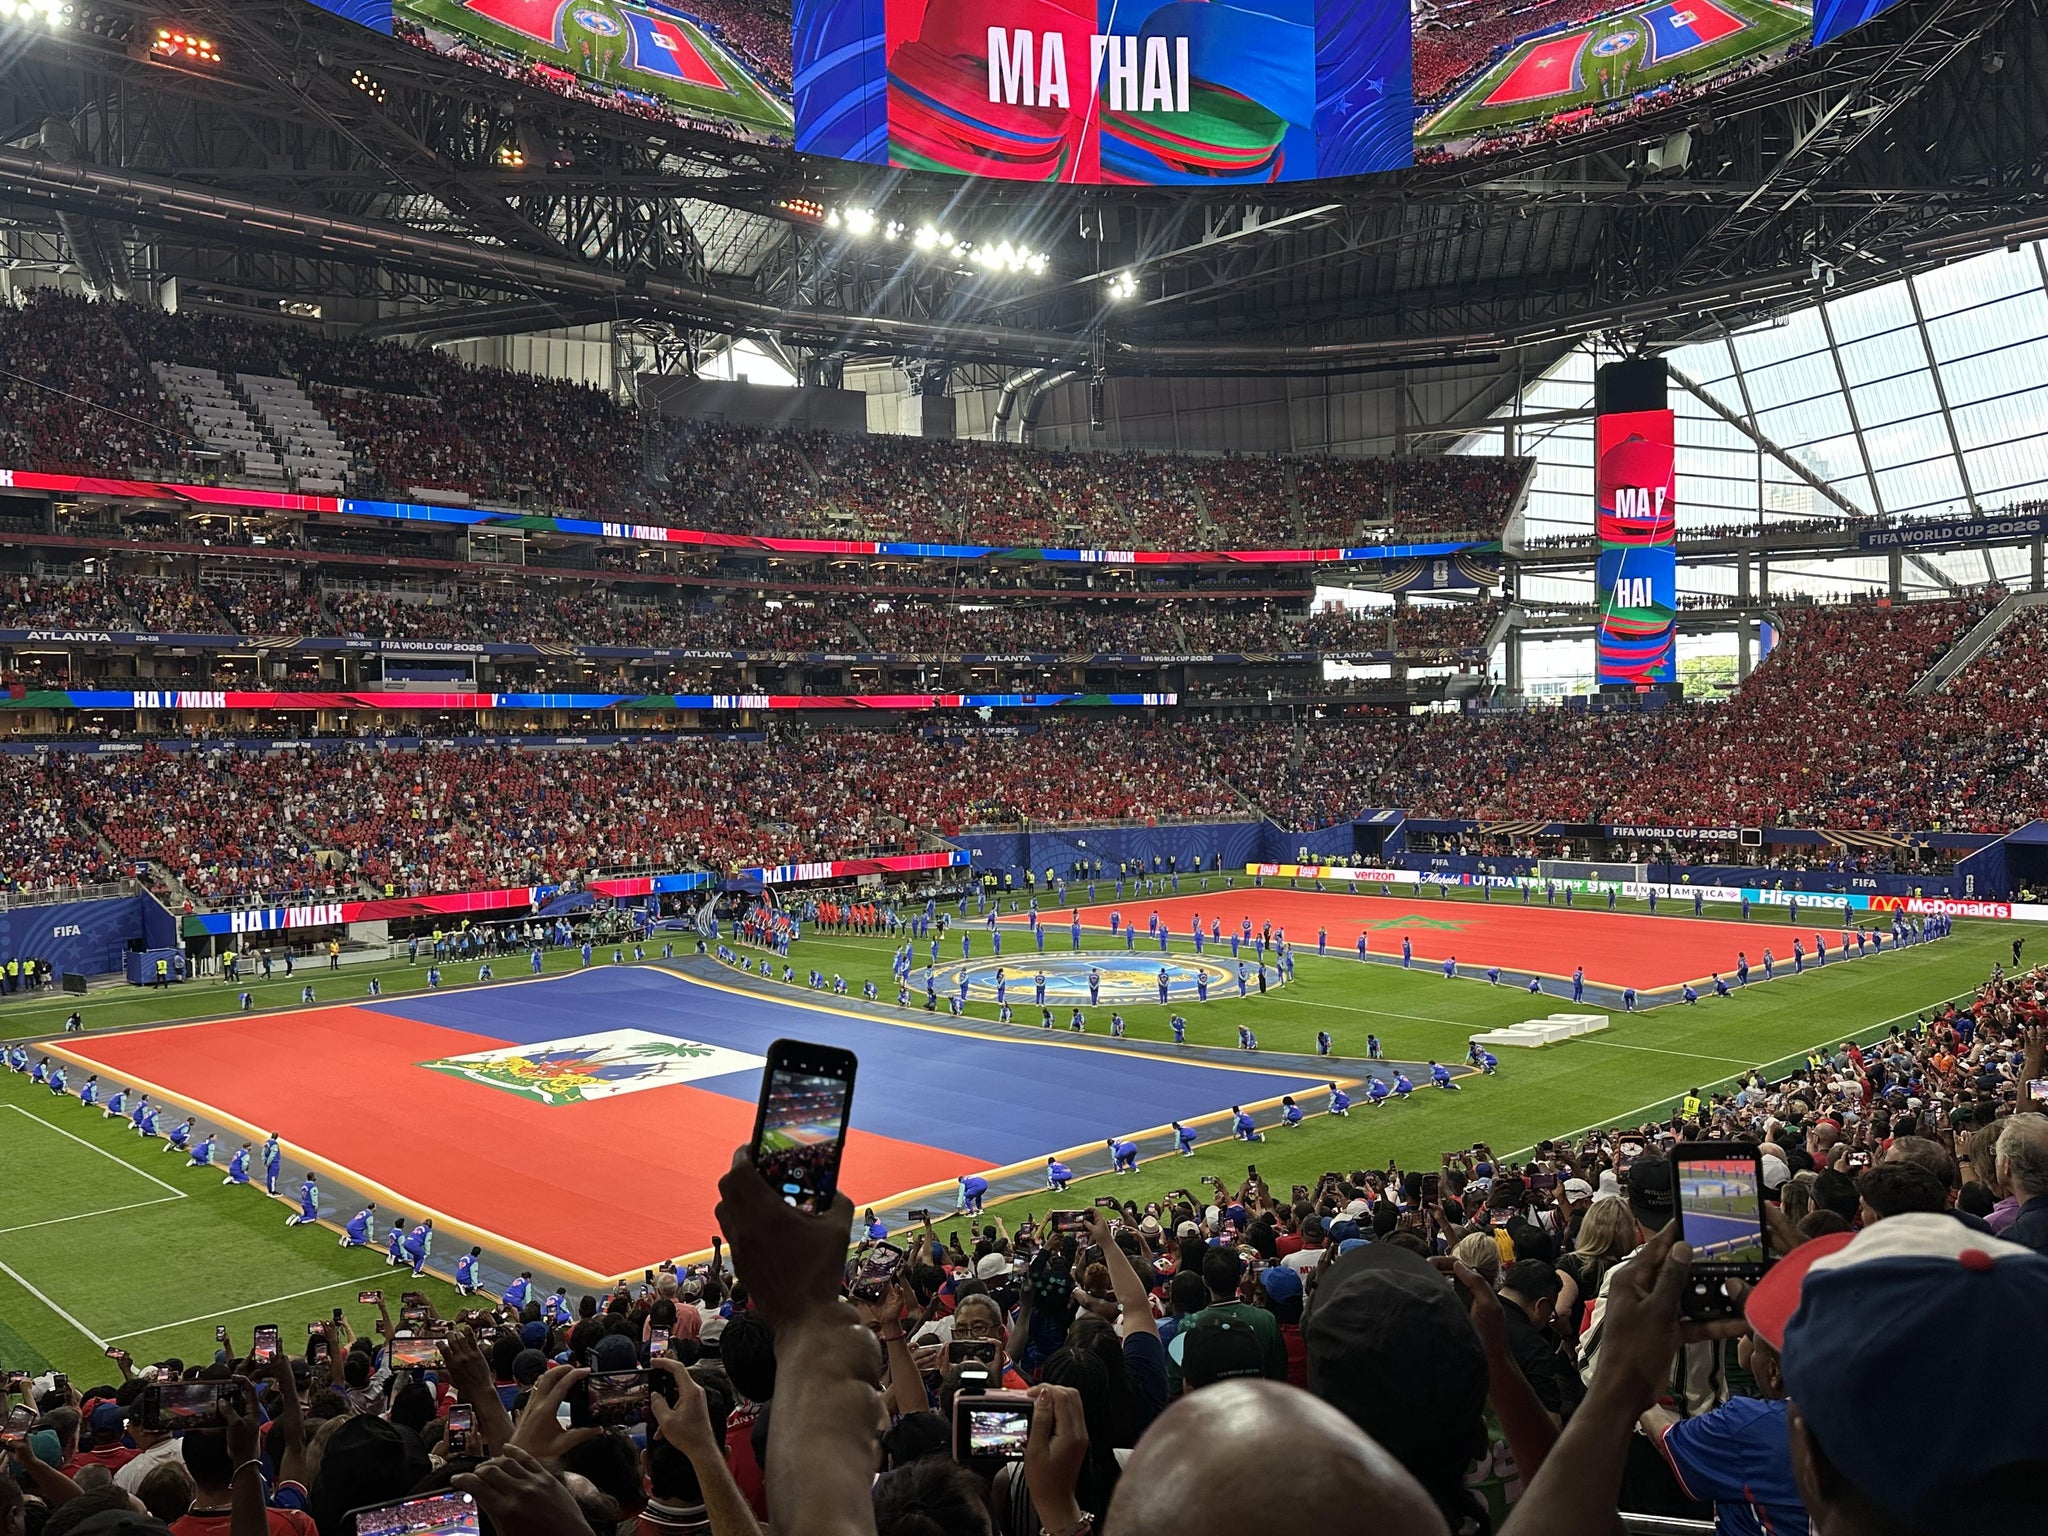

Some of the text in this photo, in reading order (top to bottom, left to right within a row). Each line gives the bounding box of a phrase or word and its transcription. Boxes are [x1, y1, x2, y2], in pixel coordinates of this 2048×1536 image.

[1109, 35, 1190, 112] HAI
[1869, 520, 2041, 545] FIFA WORLD CUP 2026
[1617, 577, 1652, 608] HAI
[27, 632, 112, 641] ATLANTA
[380, 641, 400, 650] FIFA
[401, 642, 434, 650] WORLD
[434, 643, 453, 651] CUP
[453, 644, 484, 652] 2026
[1613, 827, 1738, 840] FIFA WORLD CUP 2026
[1354, 869, 1396, 881] verizon
[1420, 871, 1461, 885] Michelob
[1852, 878, 1877, 888] FIFA
[1759, 888, 1850, 909] Hisense
[1906, 899, 2009, 918] McDonald's
[53, 925, 81, 938] FIFA
